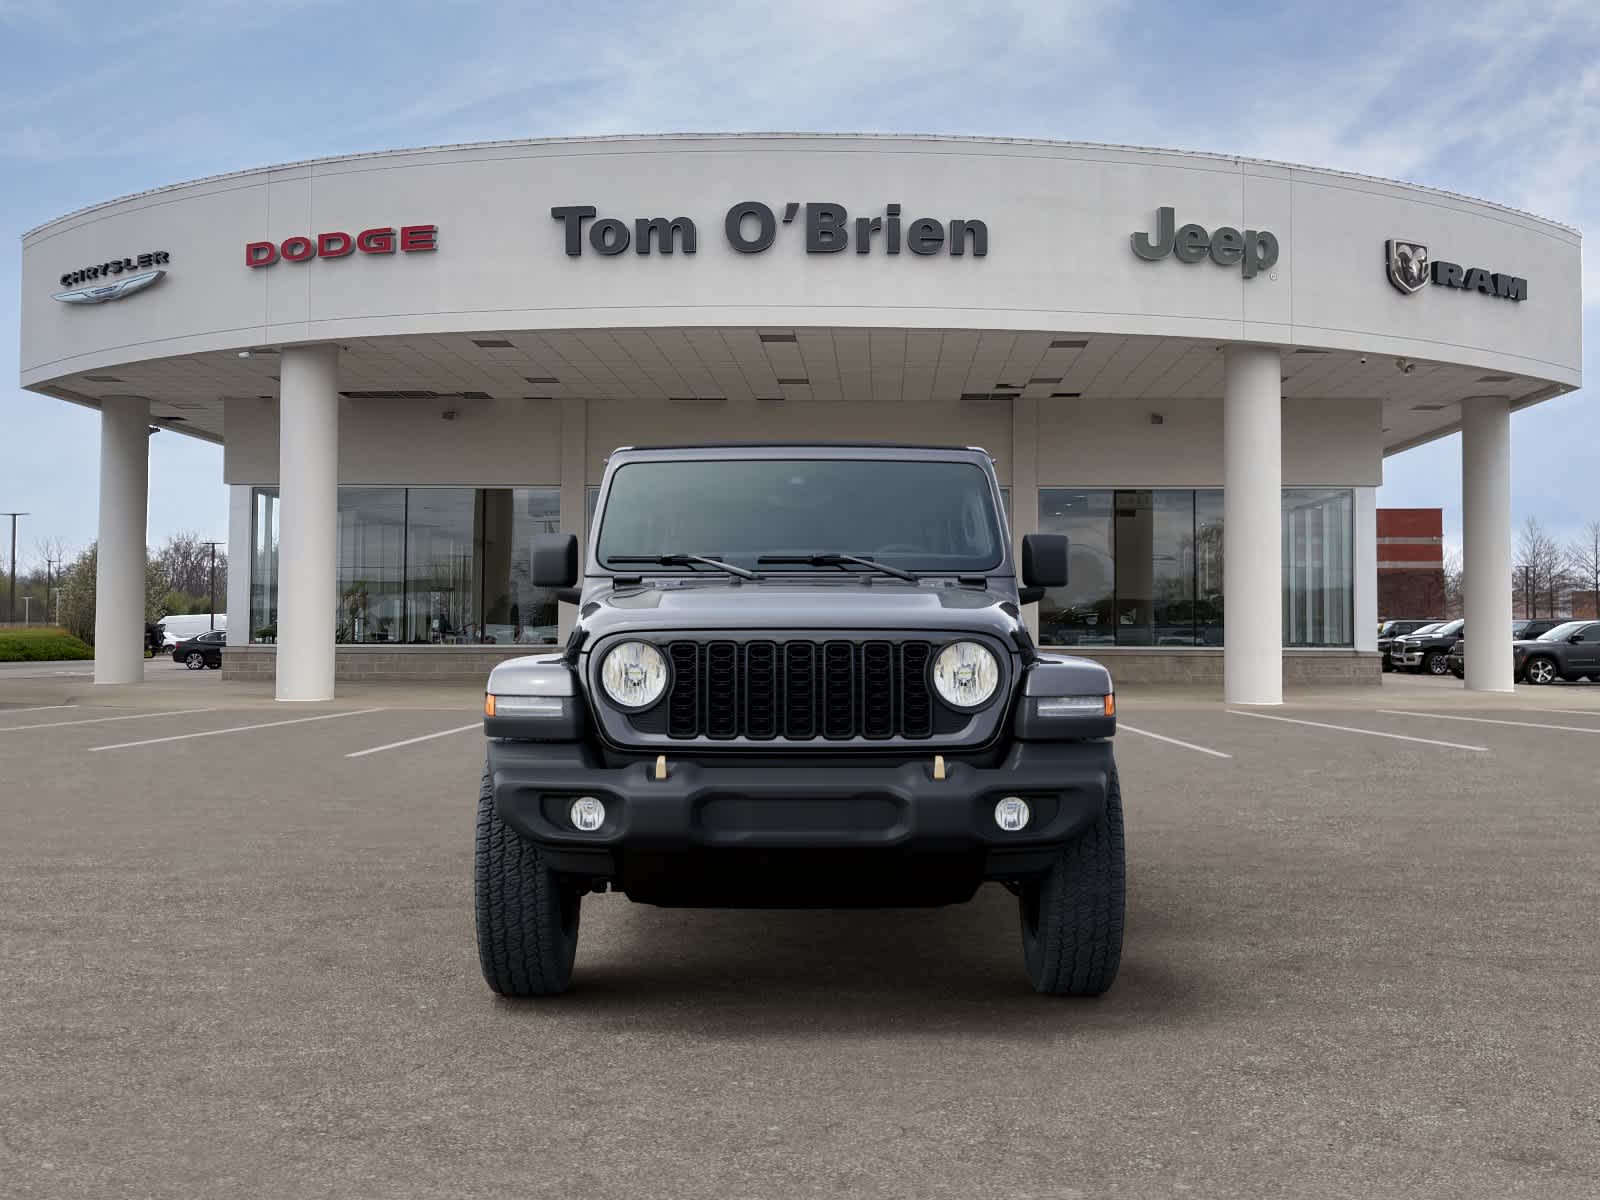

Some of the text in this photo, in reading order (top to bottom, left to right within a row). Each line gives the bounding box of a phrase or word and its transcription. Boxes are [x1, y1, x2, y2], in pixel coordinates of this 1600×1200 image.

[245, 224, 437, 269] DODGE
[551, 200, 988, 257] Tom O'Brien
[1130, 206, 1279, 279] Jeep
[60, 251, 170, 287] CHRYSLER
[1430, 260, 1528, 301] RAM
